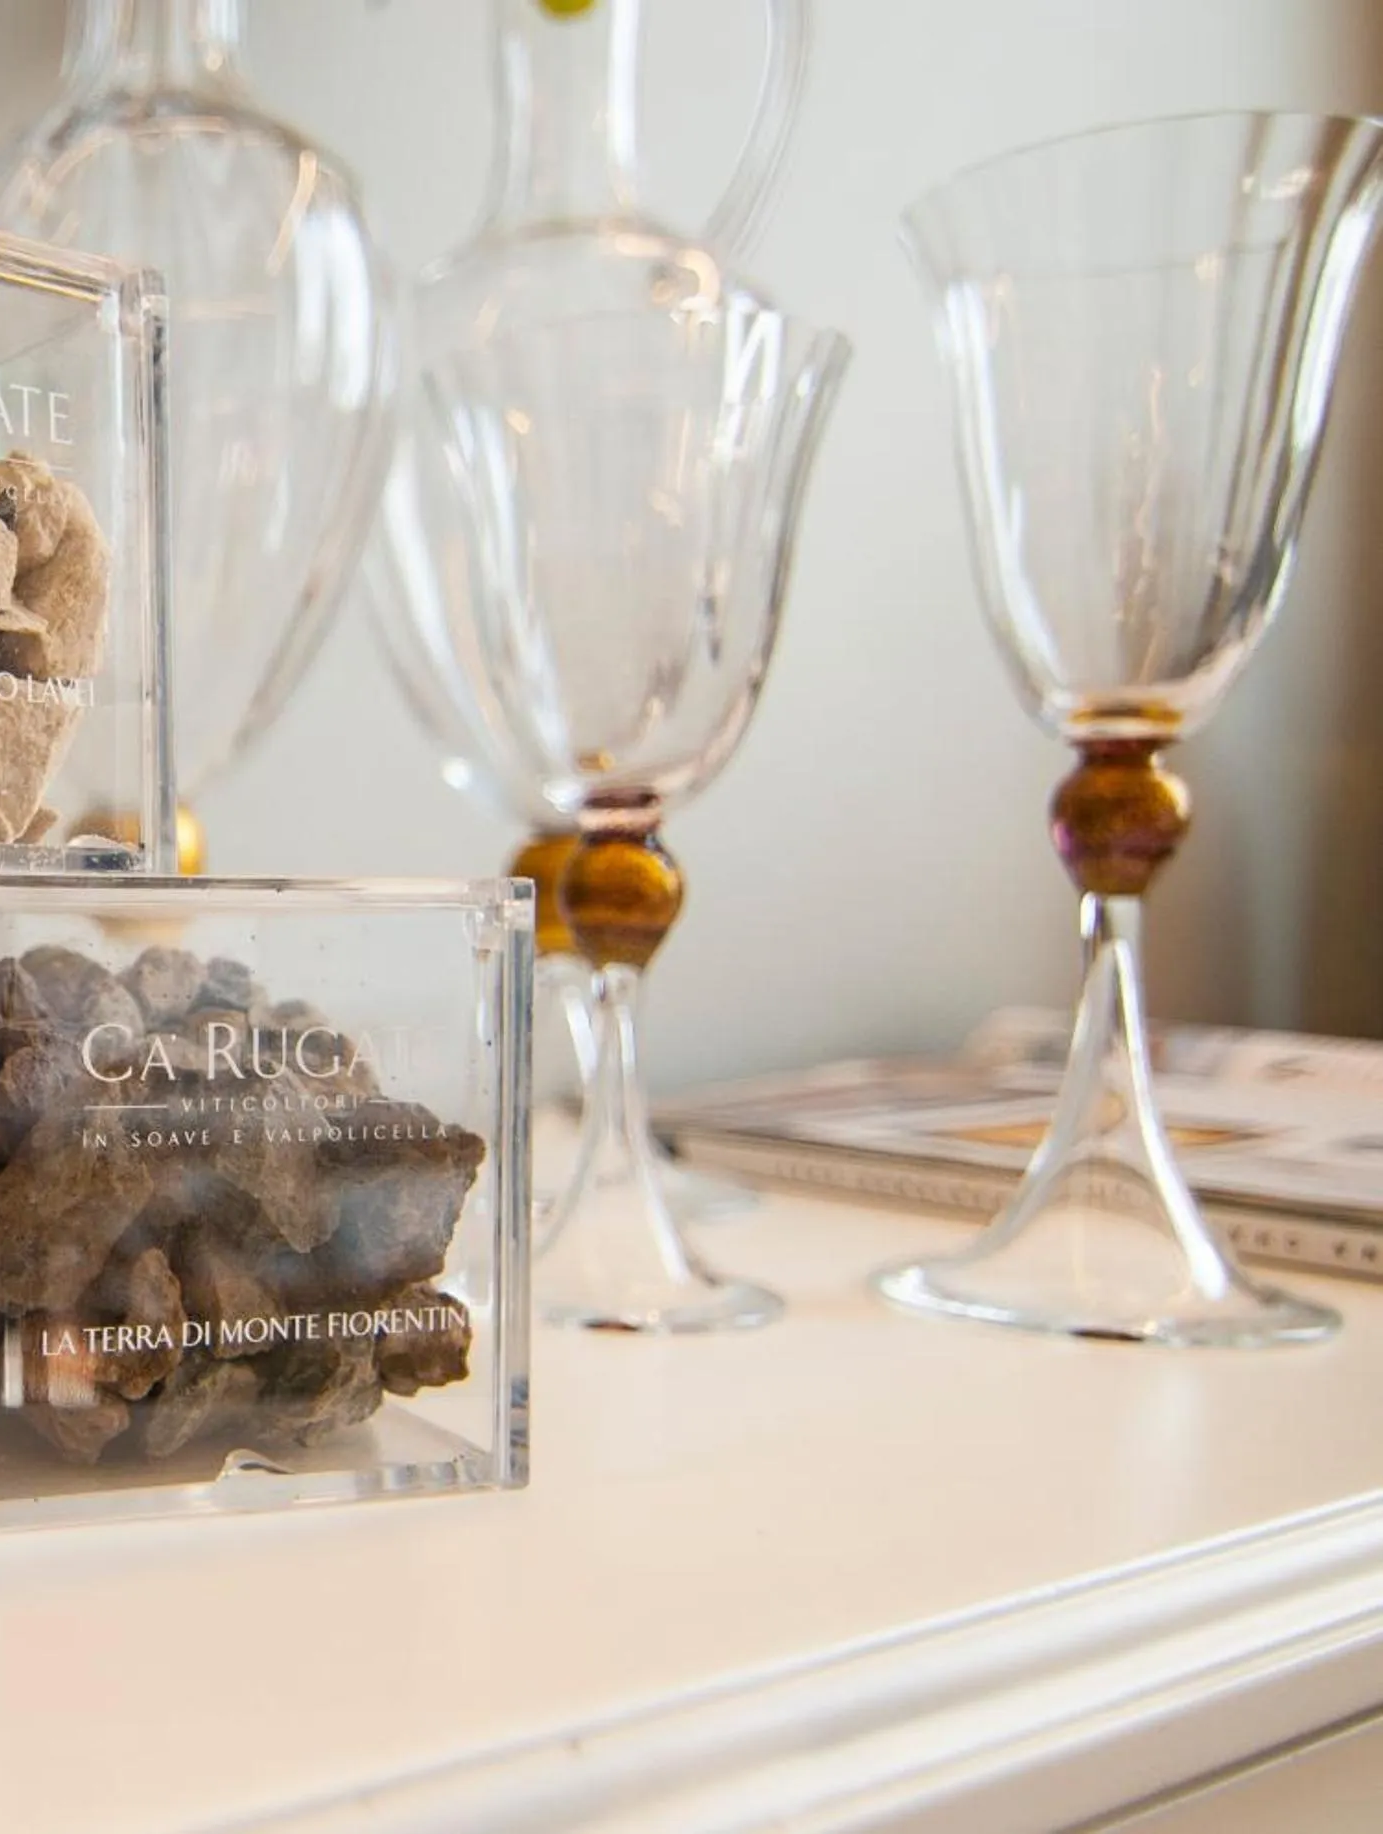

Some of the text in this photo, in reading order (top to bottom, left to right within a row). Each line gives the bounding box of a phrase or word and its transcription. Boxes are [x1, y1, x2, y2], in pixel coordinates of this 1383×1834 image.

[181, 1093, 359, 1115] VITICOLTORI
[82, 1123, 449, 1150] IN SOAVE E VALPOLICELLA
[41, 1305, 471, 1358] LA TERRA DI MONTE FIORENTIN
